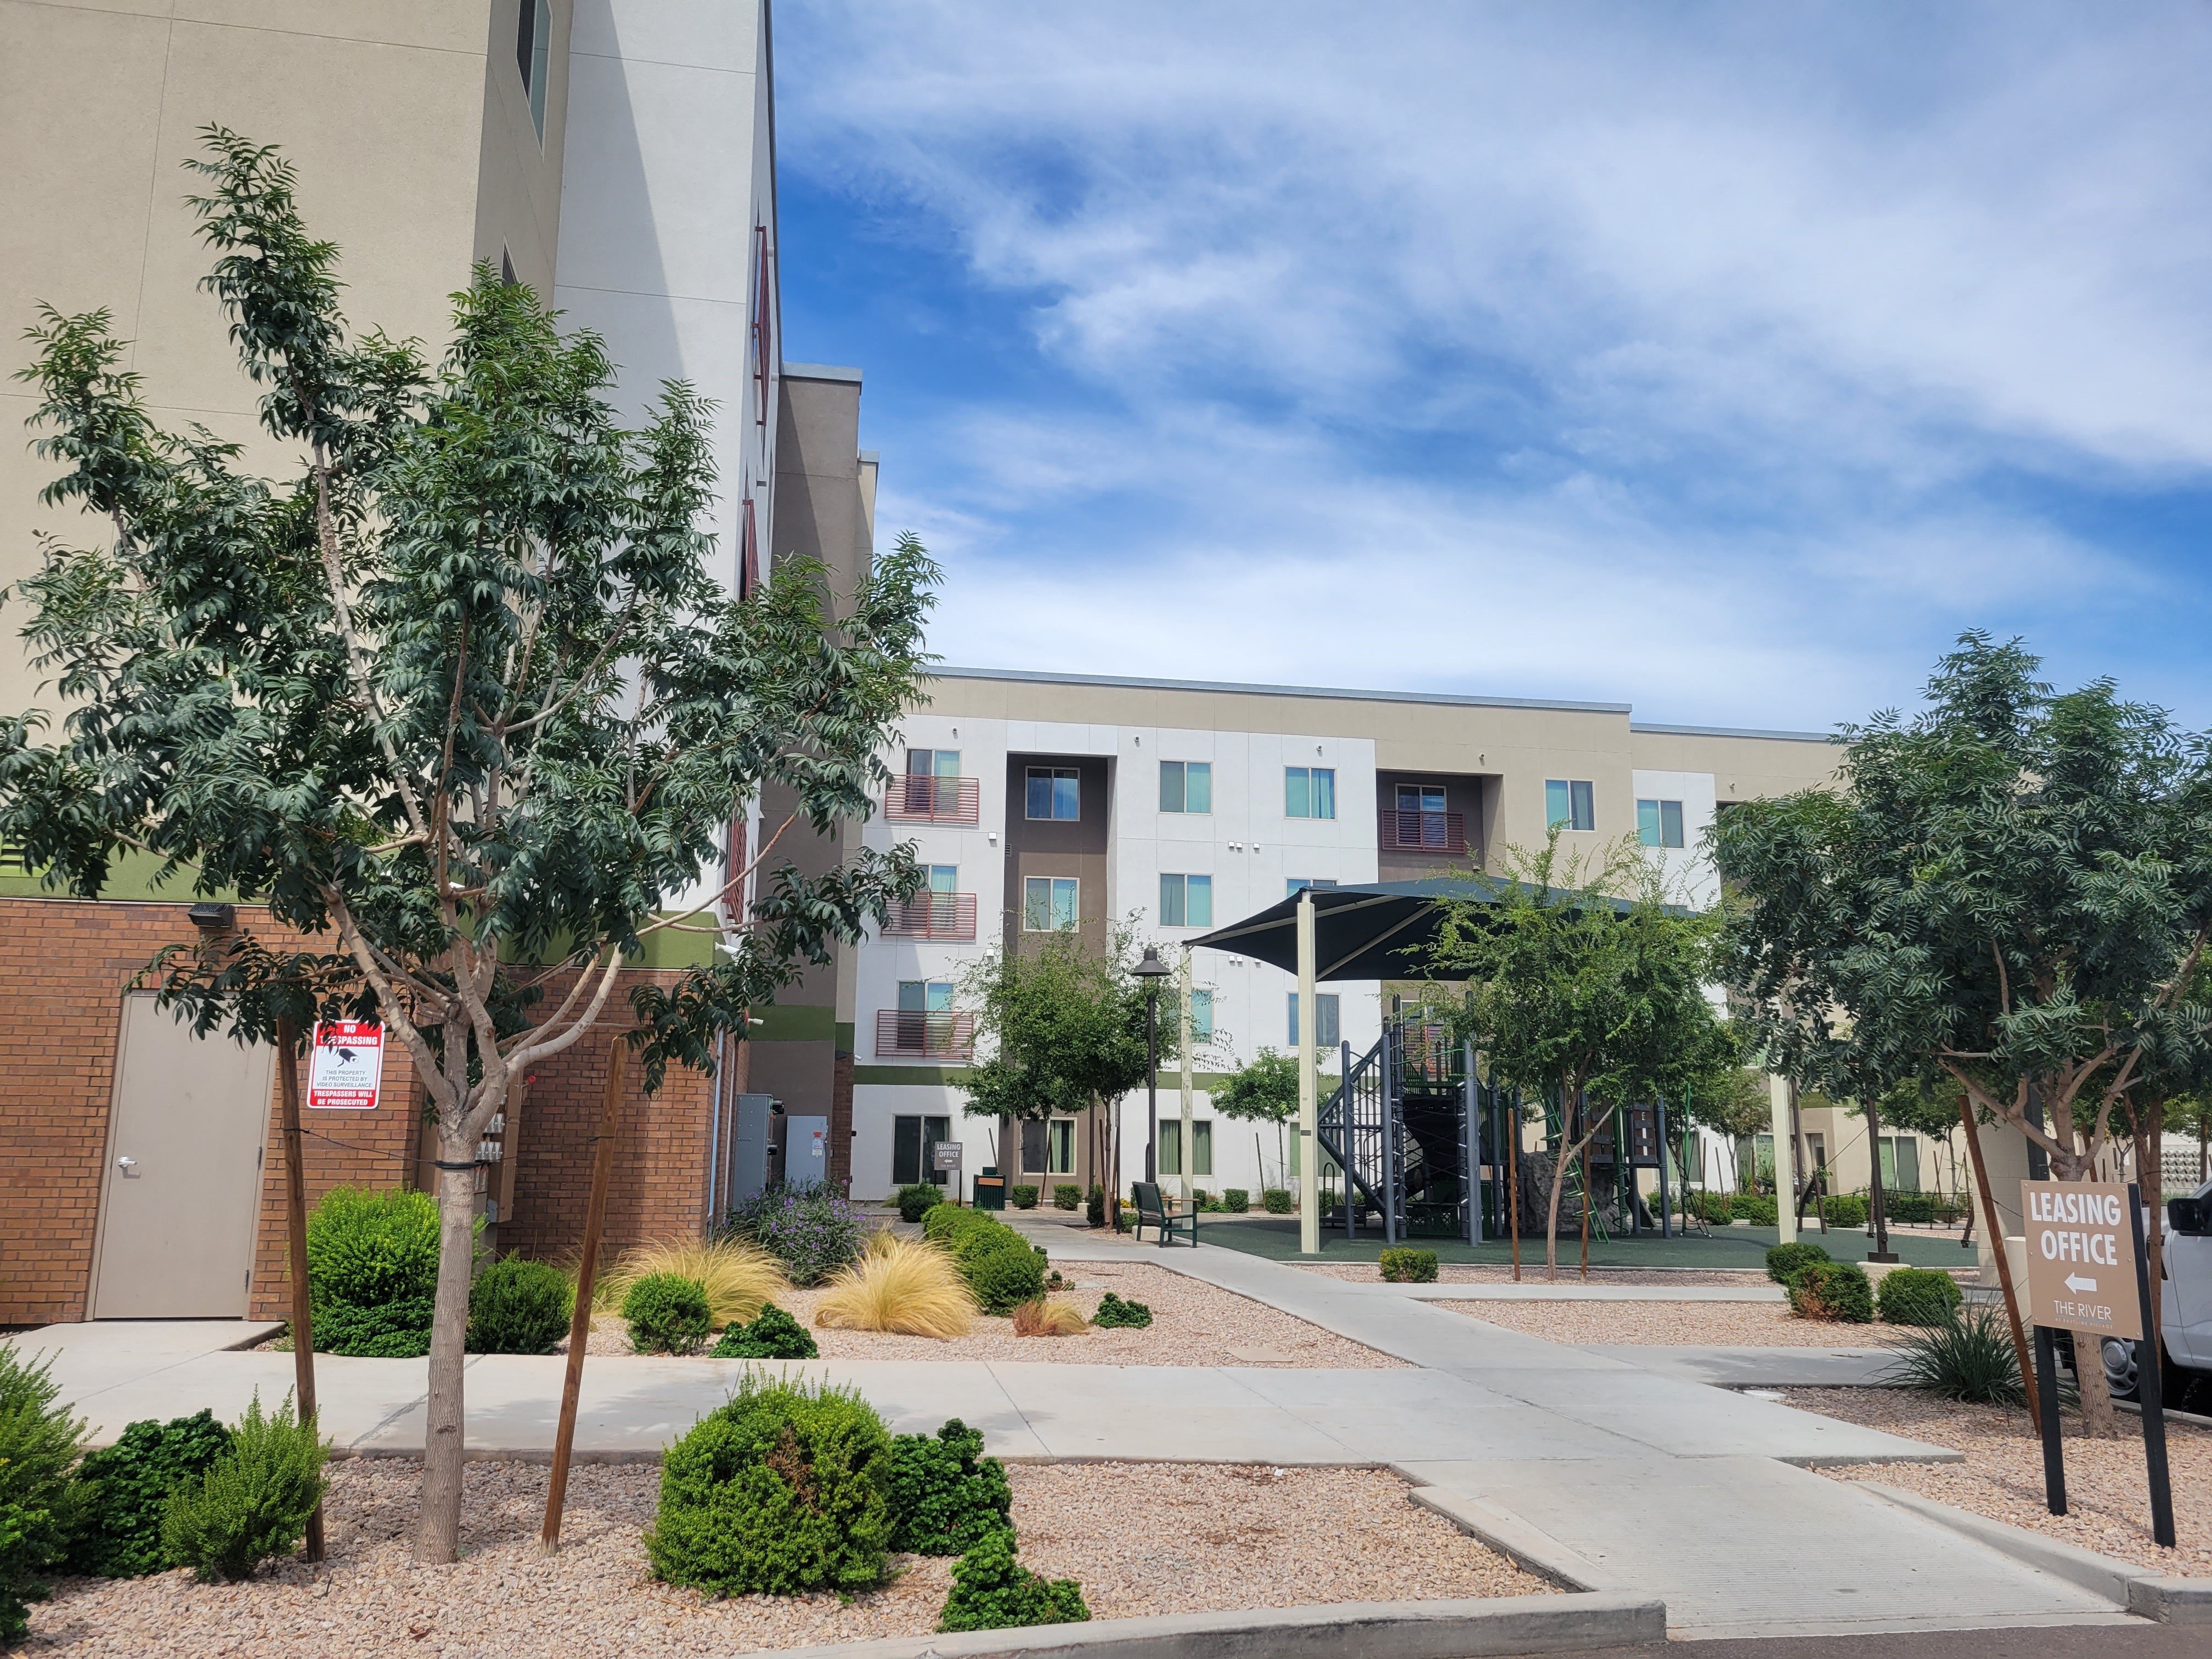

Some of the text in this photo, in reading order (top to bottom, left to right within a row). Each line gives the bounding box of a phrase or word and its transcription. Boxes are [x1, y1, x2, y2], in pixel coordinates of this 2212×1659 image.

[344, 1025, 356, 1033] NO
[320, 1036, 377, 1045] TESPASSING
[2030, 1192, 2121, 1226] LEASING
[2041, 1230, 2118, 1265] OFFICE
[2053, 1300, 2112, 1321] THE RIVER
